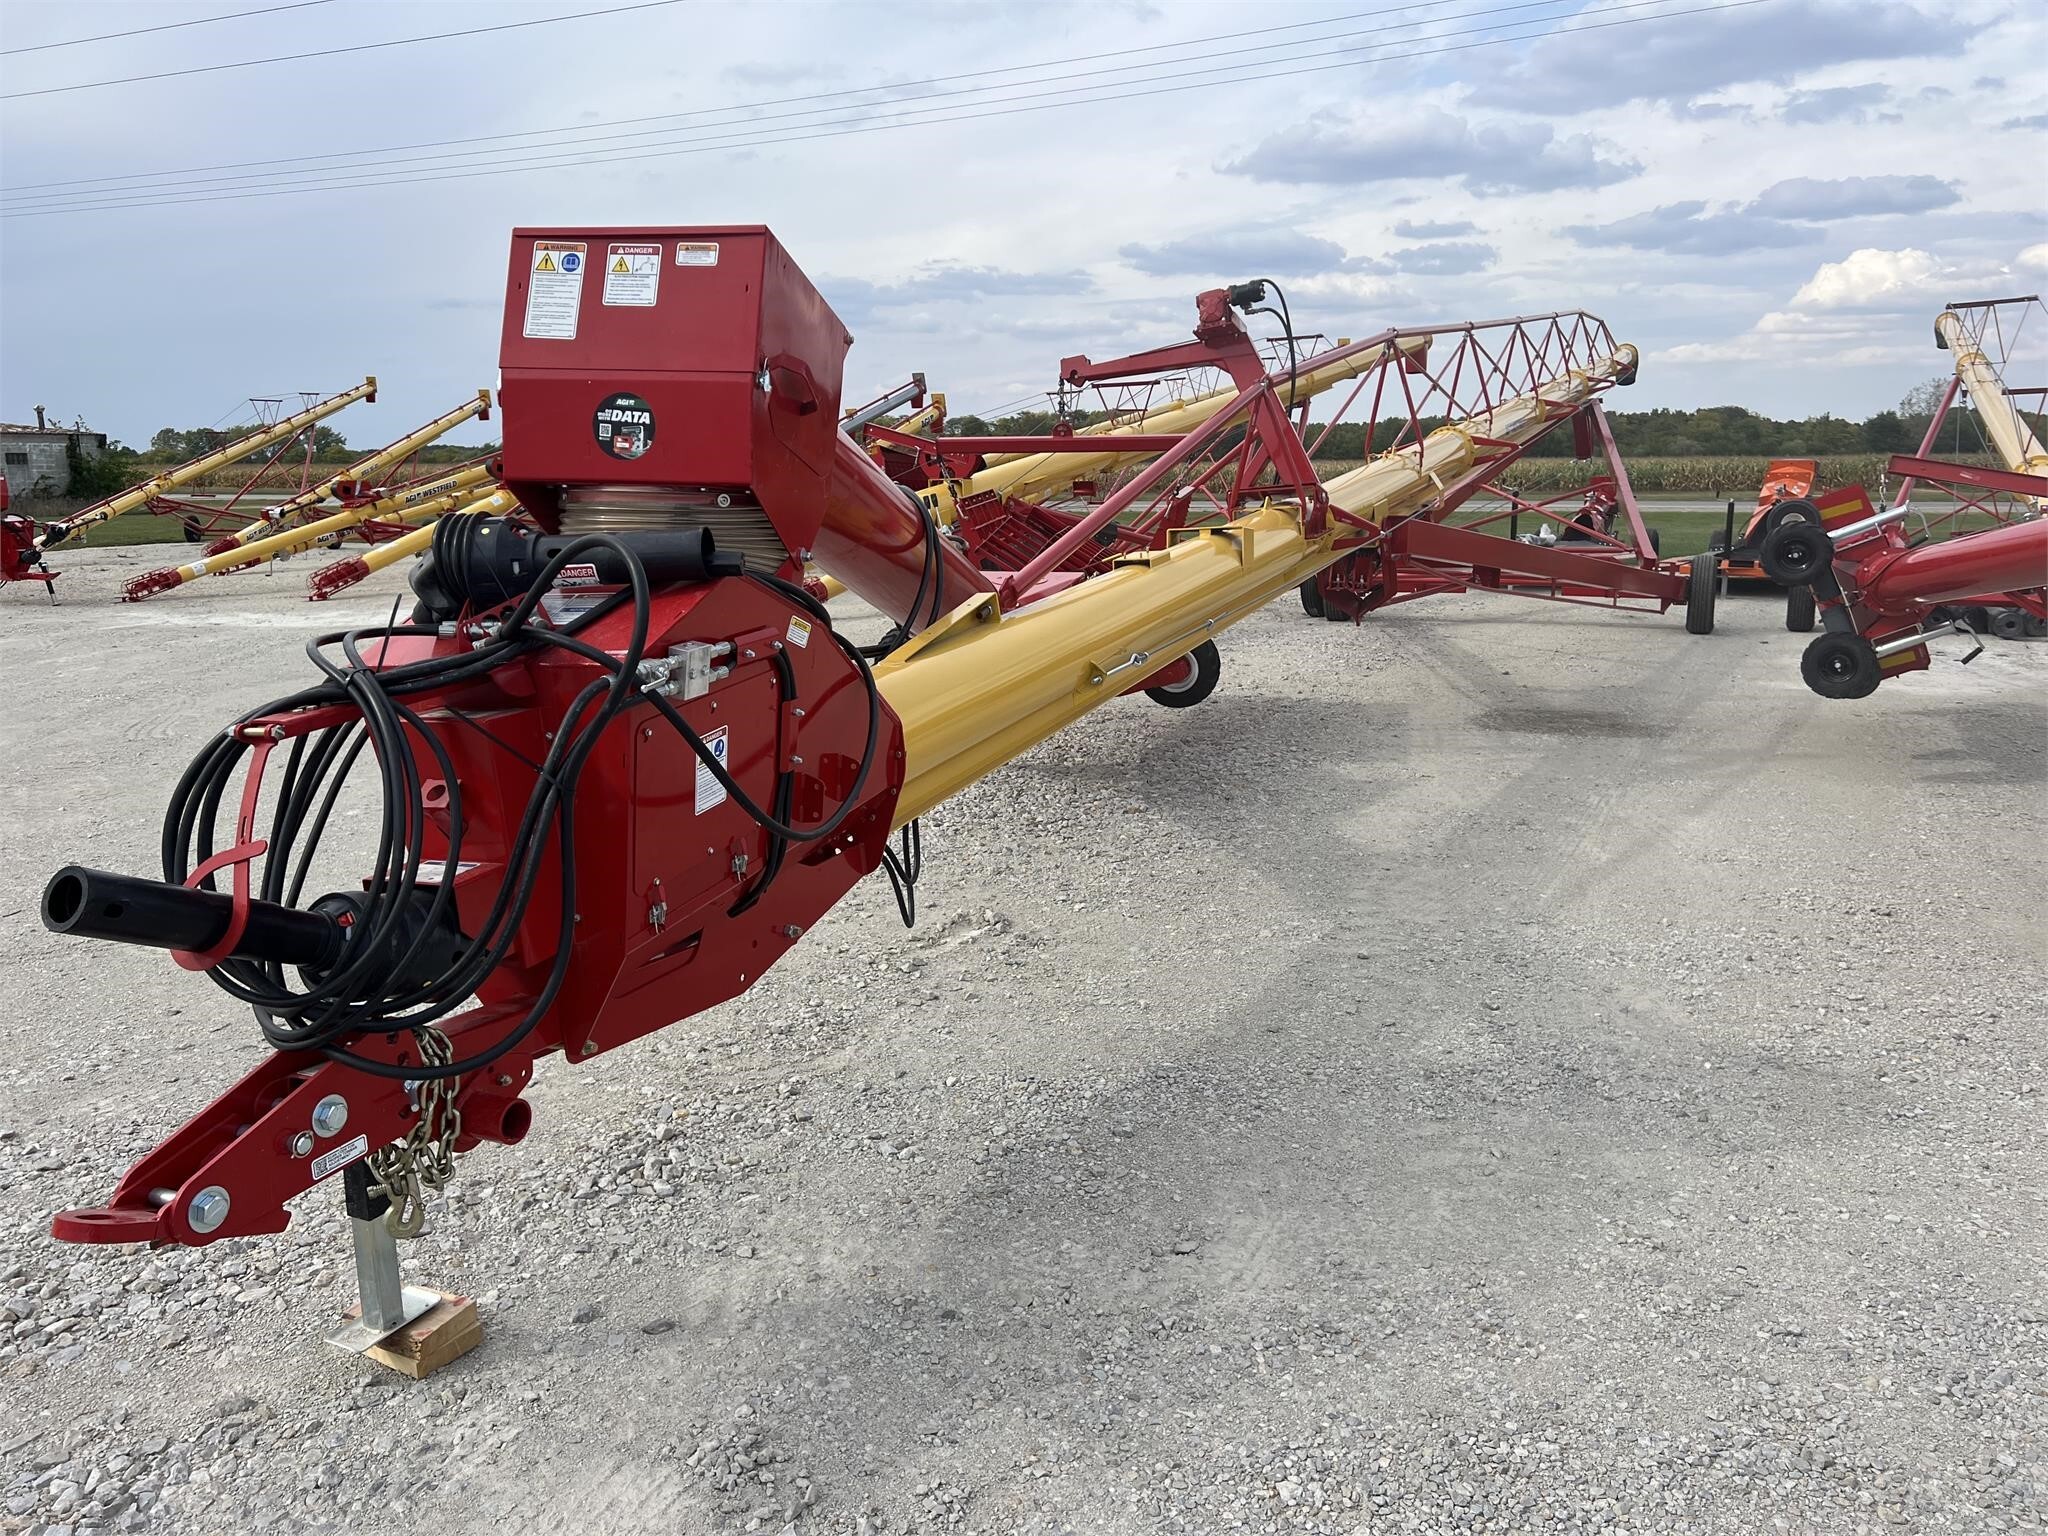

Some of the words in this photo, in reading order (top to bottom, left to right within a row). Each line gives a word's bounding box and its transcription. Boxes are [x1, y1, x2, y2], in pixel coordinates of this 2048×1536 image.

[616, 398, 628, 406] AGI
[611, 409, 651, 425] DATA
[422, 480, 458, 498] WESTFIELD
[317, 535, 329, 543] AGI
[560, 568, 595, 578] DANGER
[706, 730, 723, 742] DANGER
